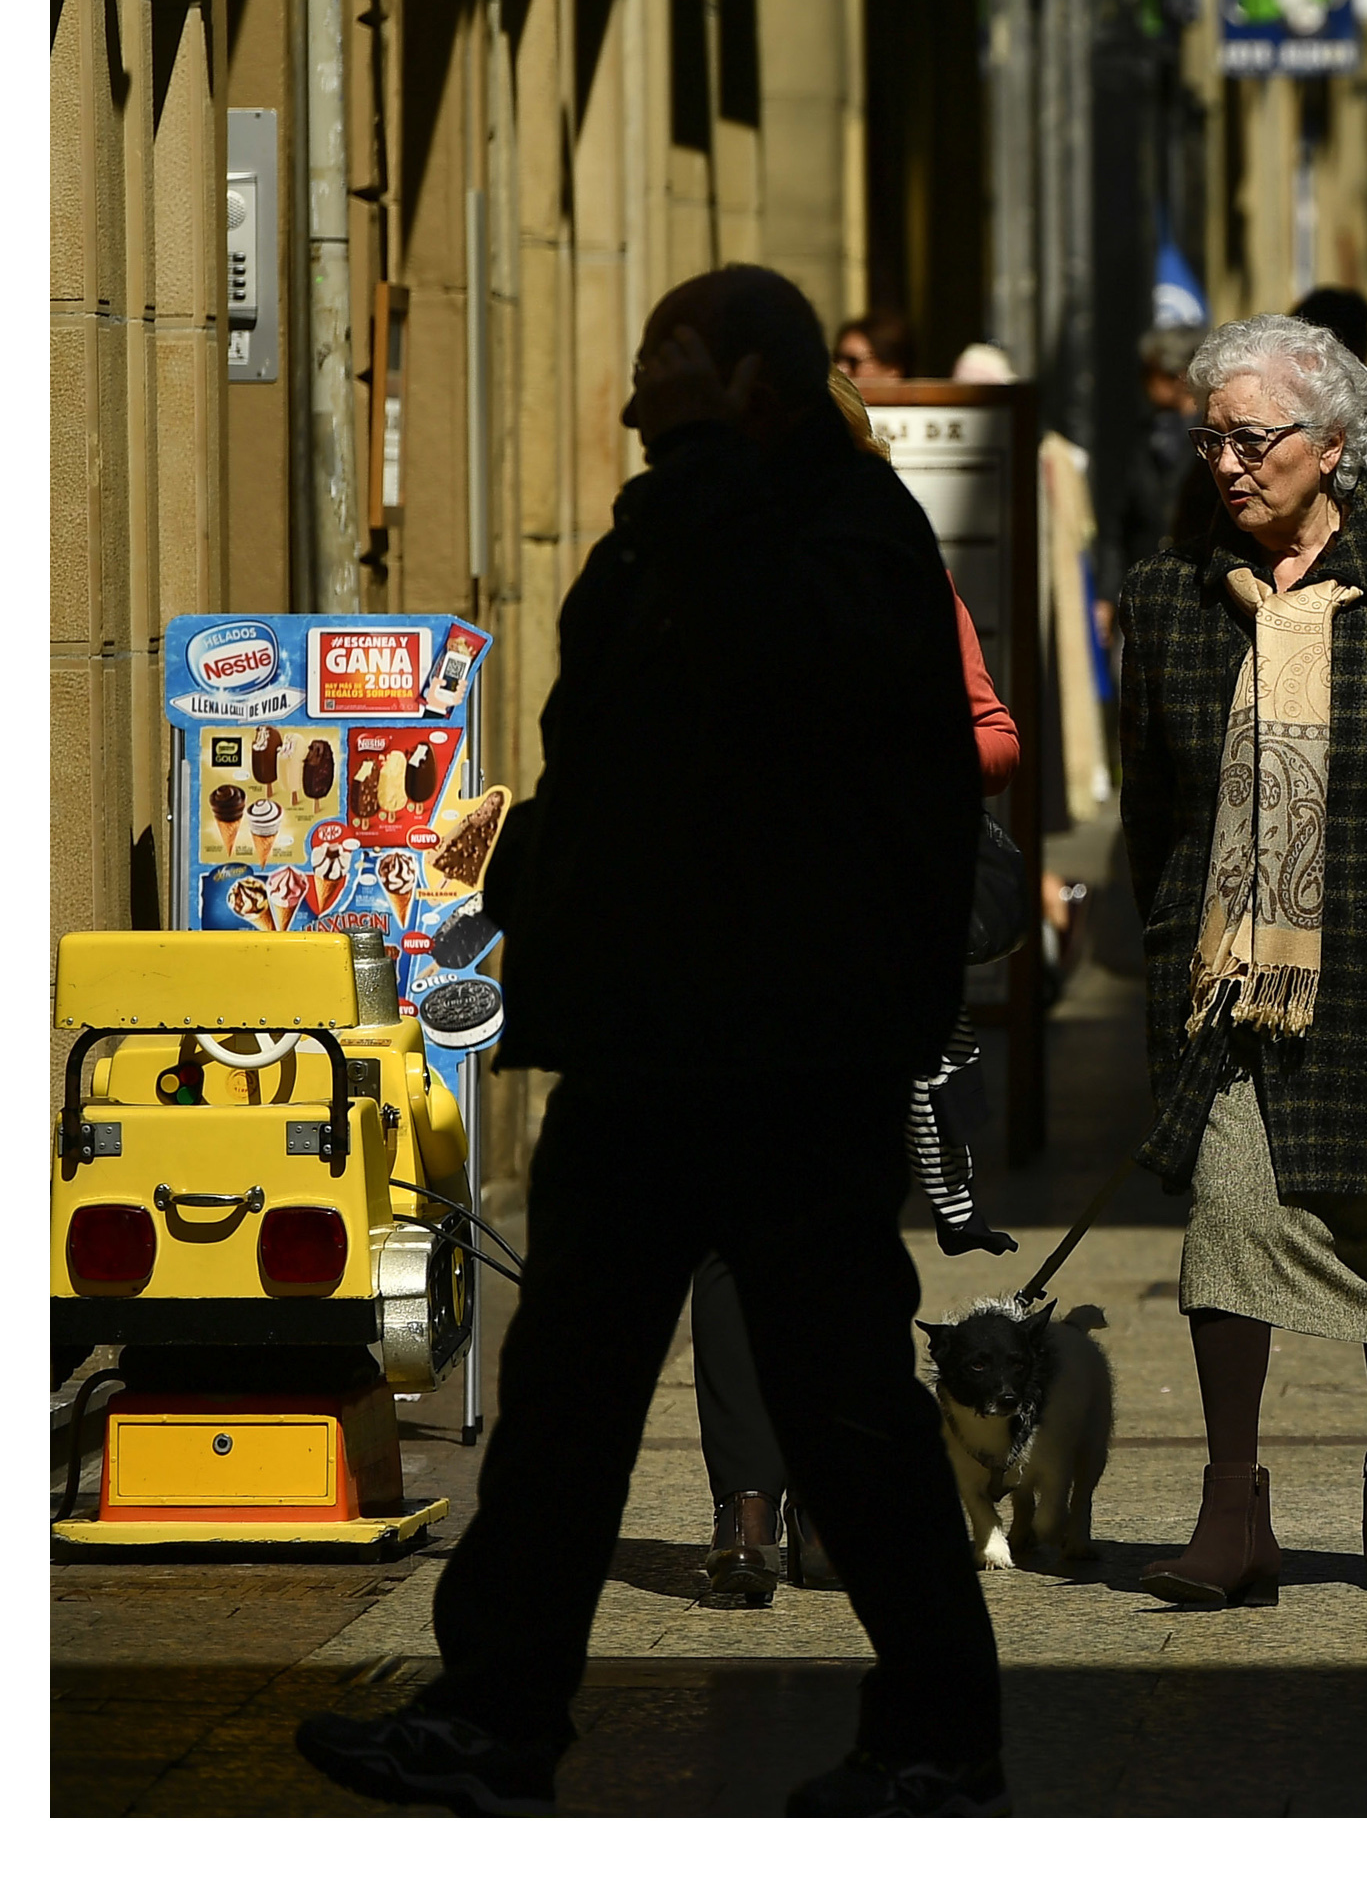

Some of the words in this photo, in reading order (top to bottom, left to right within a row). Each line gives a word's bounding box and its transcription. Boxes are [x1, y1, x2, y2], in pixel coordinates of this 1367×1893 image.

[204, 627, 257, 648] HELADOS
[331, 636, 396, 648] #ESCANEA
[400, 637, 408, 648] Y
[325, 648, 412, 674] GANA
[365, 674, 413, 690] 2.000
[325, 689, 363, 698] REGALOS
[366, 689, 413, 698] SORPRESA
[191, 697, 219, 714] LLENA
[220, 703, 229, 715] LA
[249, 703, 259, 718] DE
[215, 755, 238, 763] GOLD
[411, 834, 437, 843] NUEVO
[403, 938, 430, 949] NUEVO
[411, 974, 458, 993] OREO
